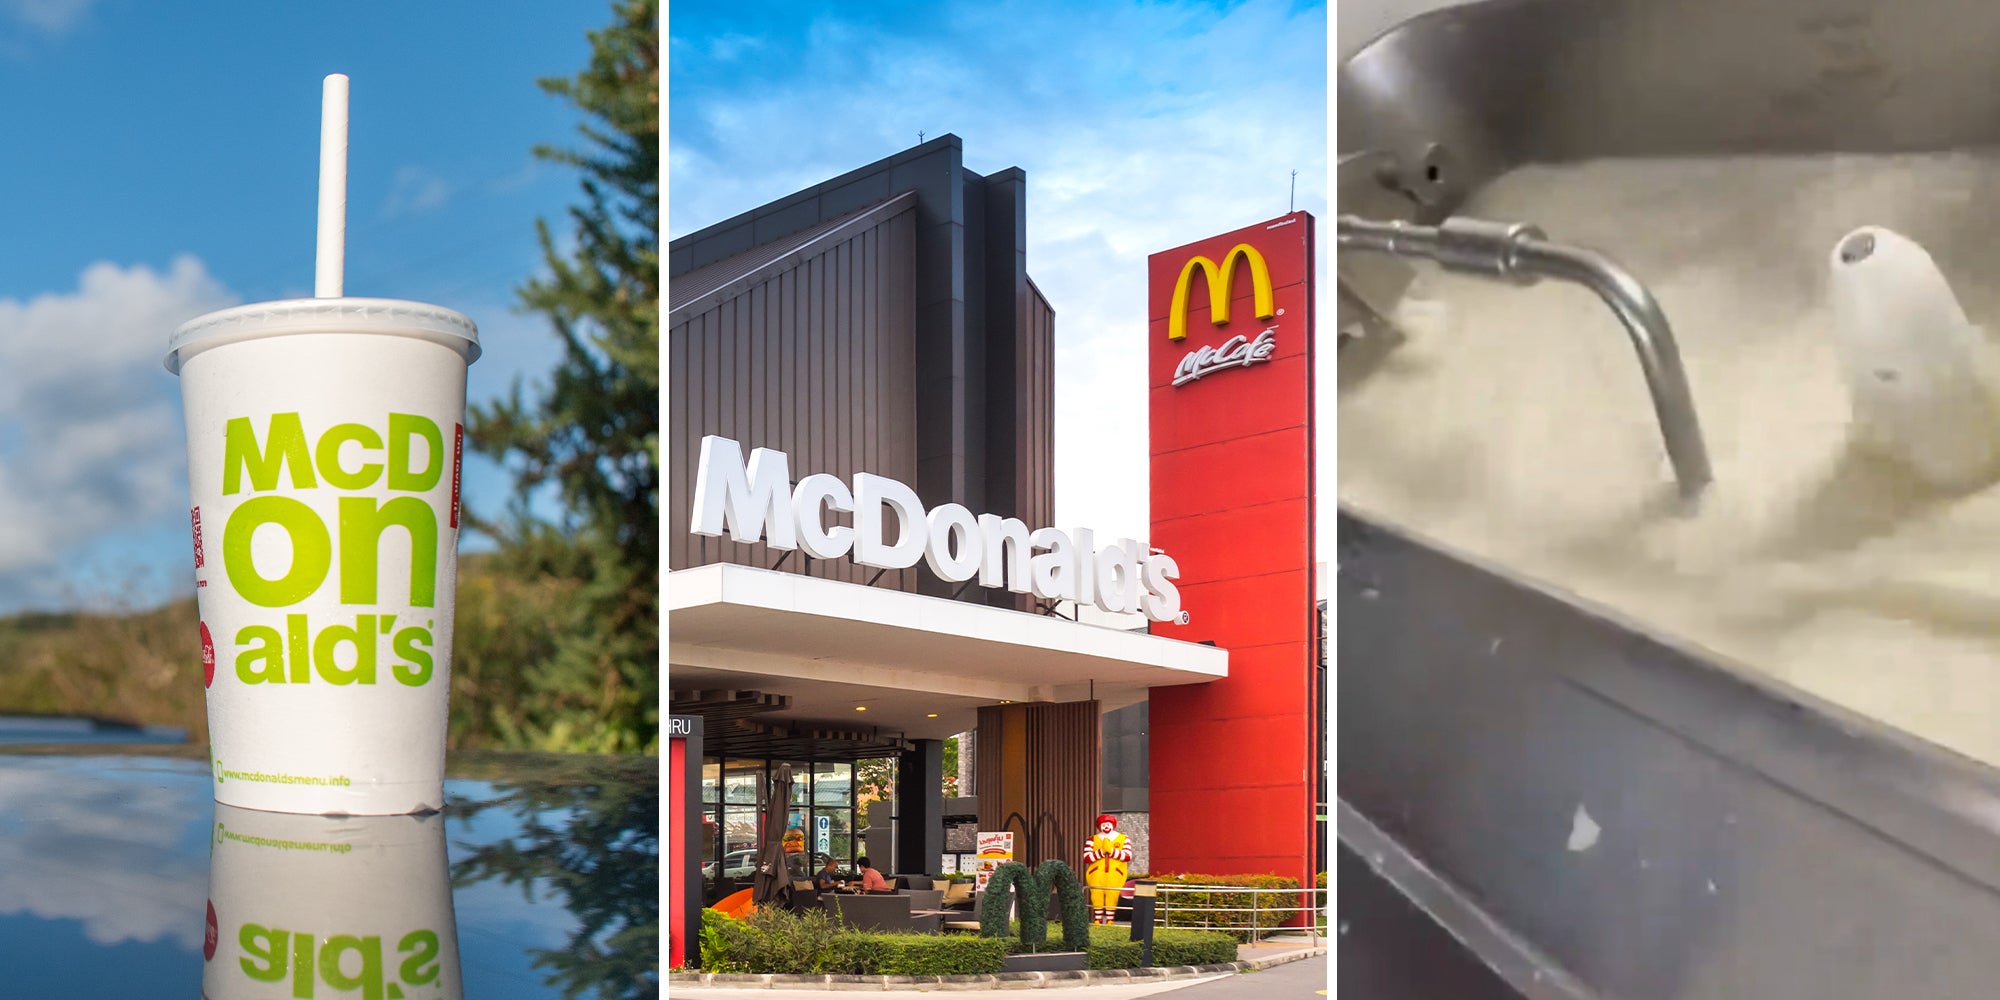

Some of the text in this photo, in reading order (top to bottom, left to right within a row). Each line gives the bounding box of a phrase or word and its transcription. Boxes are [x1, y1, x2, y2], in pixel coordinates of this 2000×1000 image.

[222, 412, 444, 496] McD
[222, 495, 438, 608] on
[690, 434, 1182, 623] McDonald's
[234, 614, 434, 687] ald's
[223, 768, 351, 787] www.mcdonaldsmenu.info
